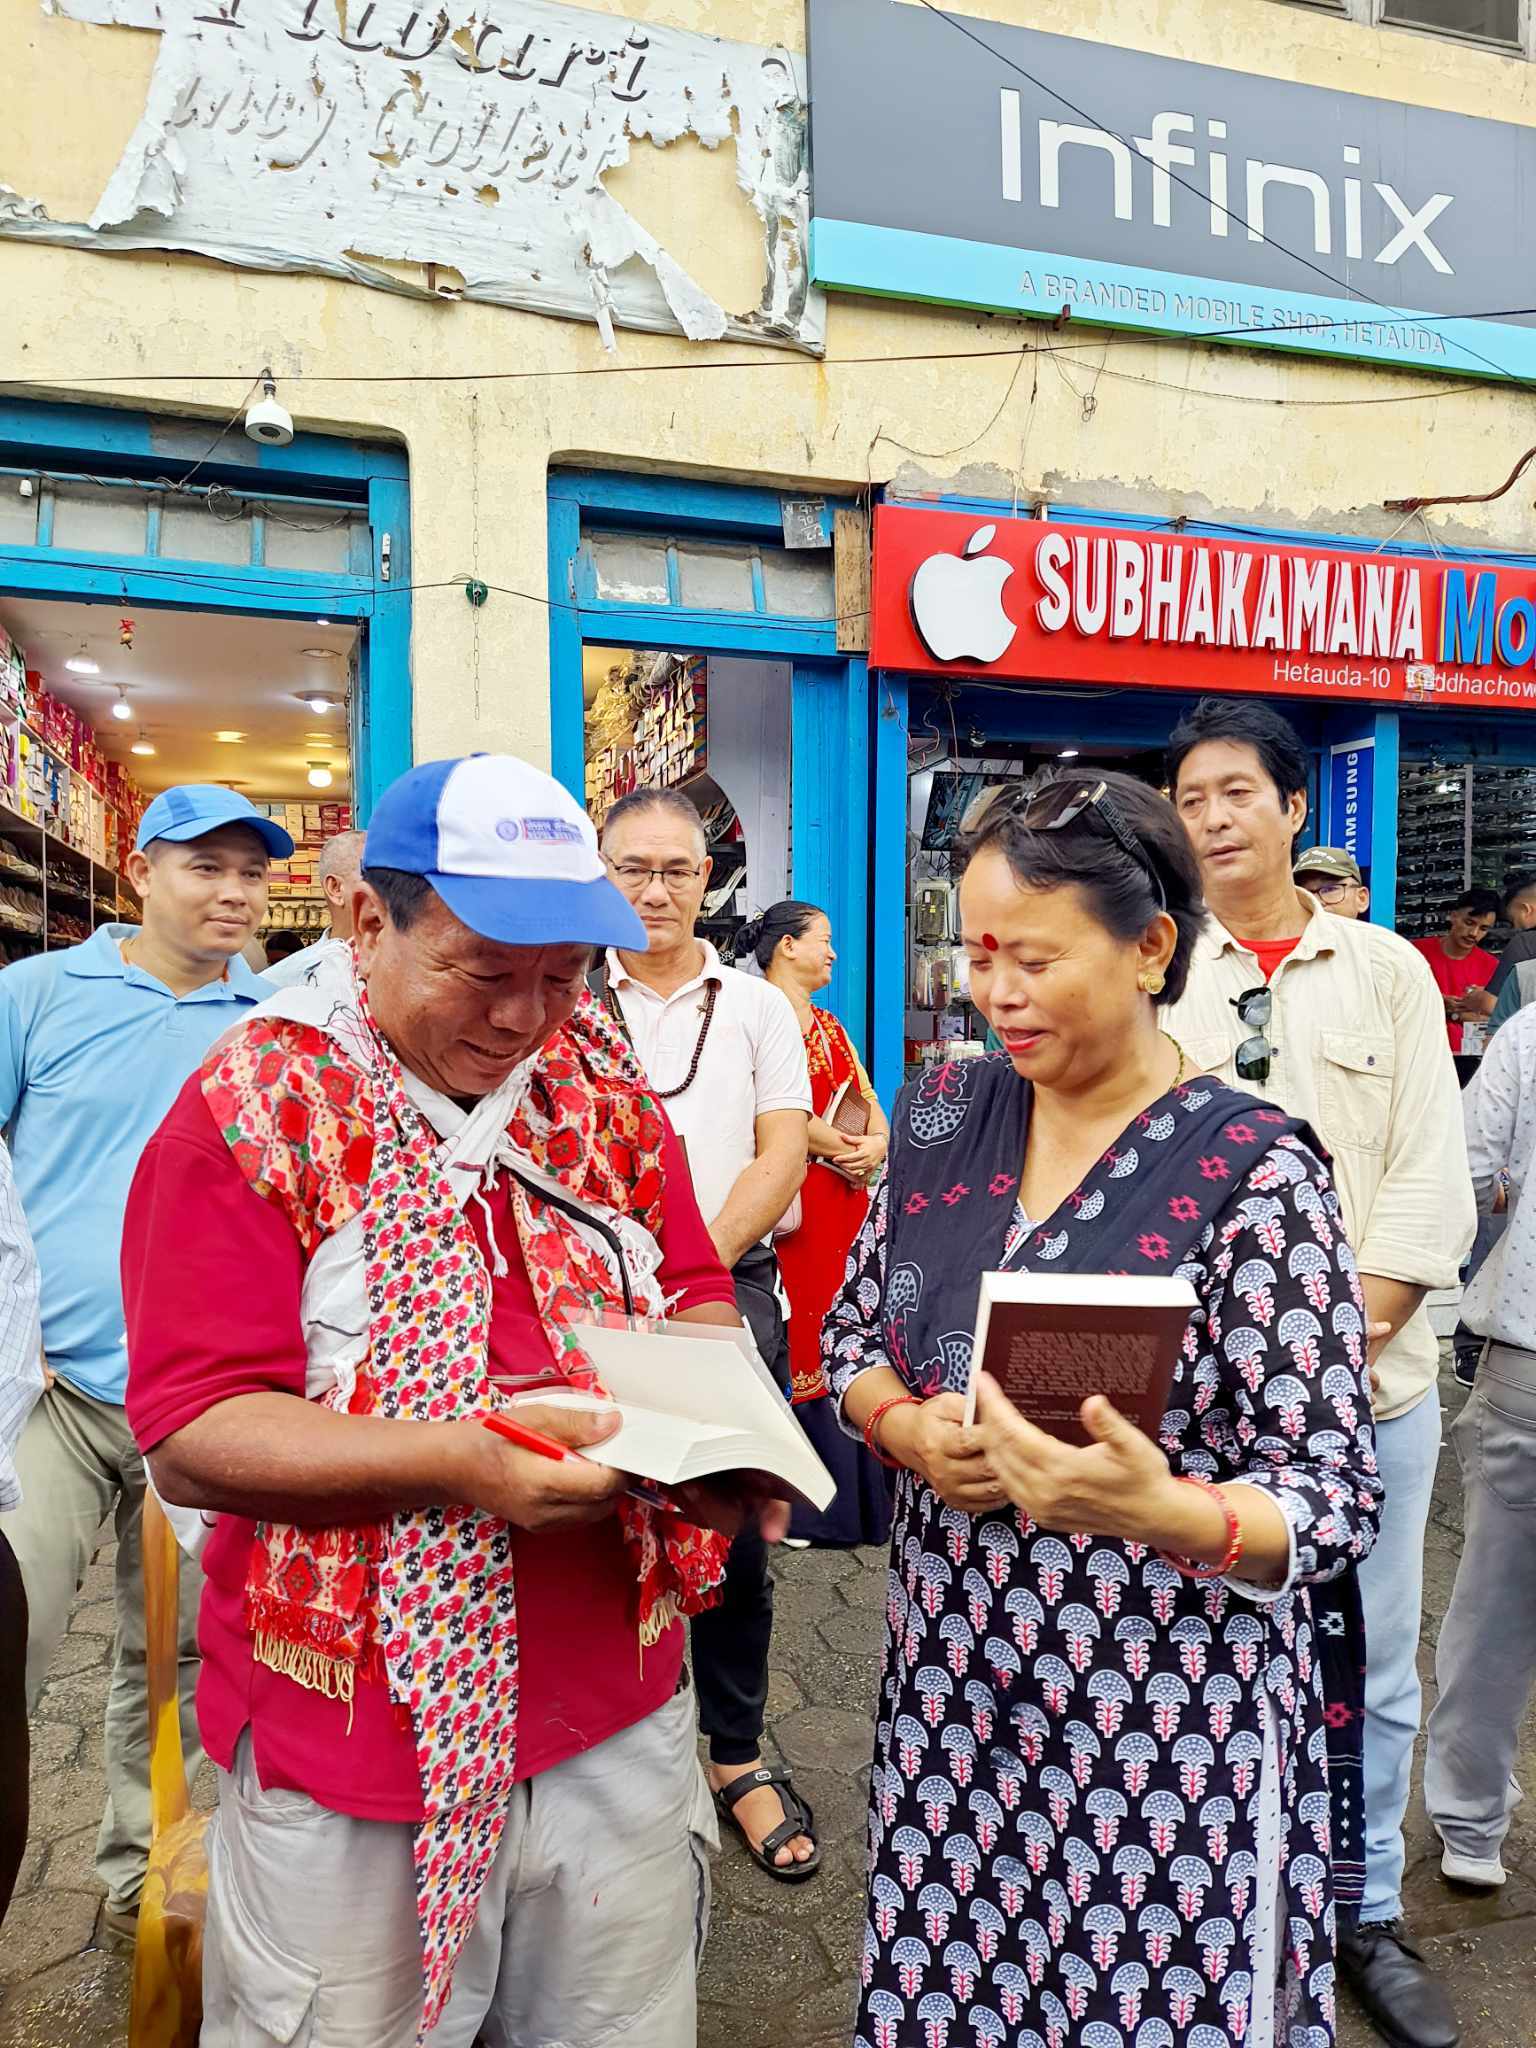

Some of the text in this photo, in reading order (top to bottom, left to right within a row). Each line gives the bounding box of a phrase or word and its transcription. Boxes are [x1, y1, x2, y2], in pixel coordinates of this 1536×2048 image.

[1000, 86, 1456, 275] Infinix
[1020, 270, 1038, 297] A
[1044, 273, 1167, 313] BRANDED
[1174, 293, 1265, 329] MOBILE
[1343, 318, 1447, 356] HETAUDA
[1033, 531, 1536, 669] SUBHAKAMANA Mo
[1273, 659, 1536, 698] Hetauda-10 ddhachow
